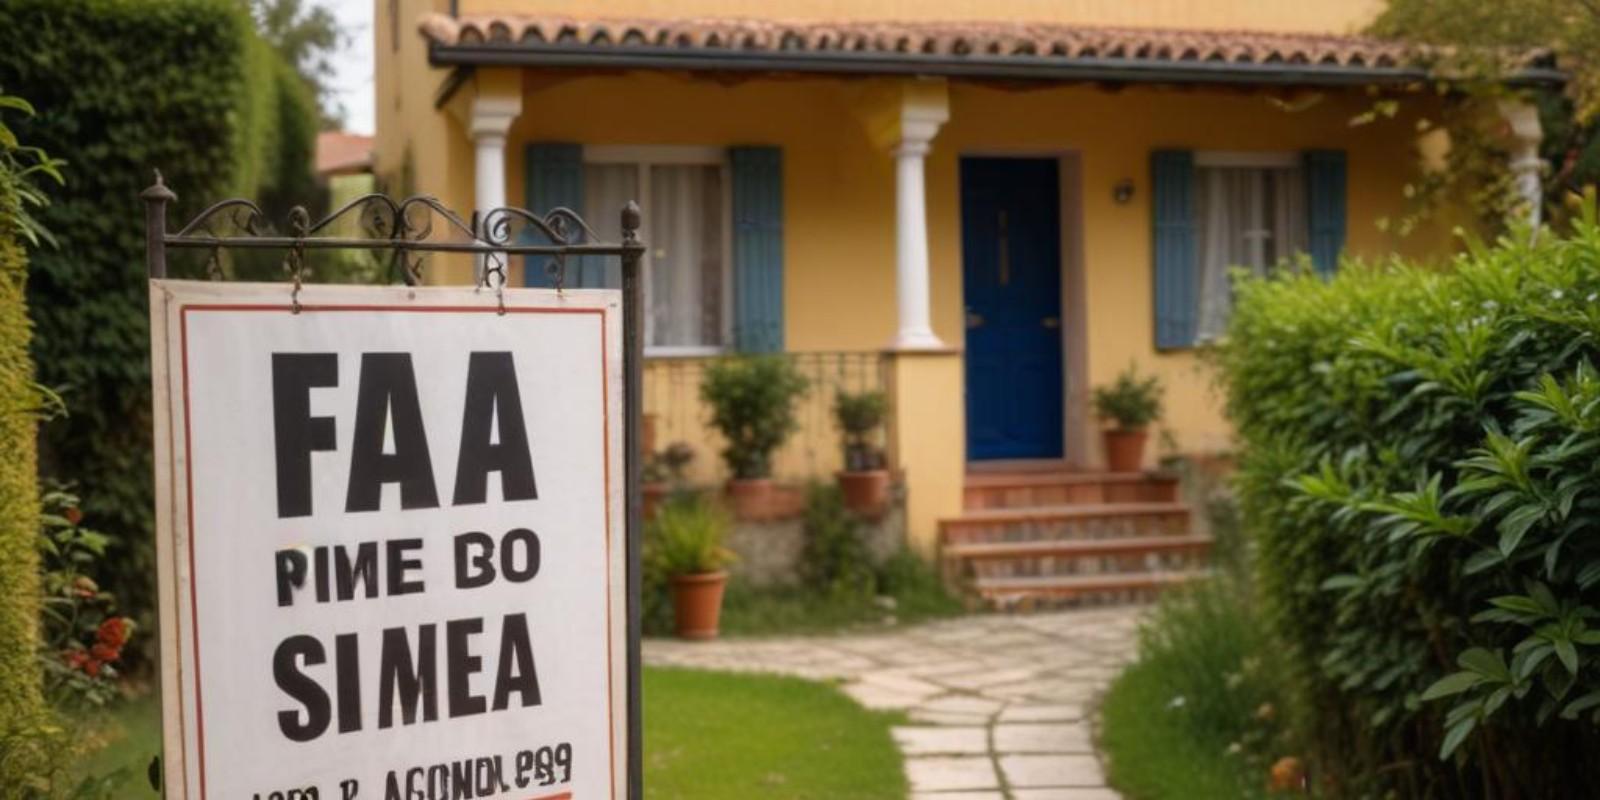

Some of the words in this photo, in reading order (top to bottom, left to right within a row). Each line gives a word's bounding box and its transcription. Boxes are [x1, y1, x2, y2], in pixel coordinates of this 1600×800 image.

[271, 351, 538, 519] FAA
[275, 538, 425, 607] PIME
[454, 528, 540, 589] BO
